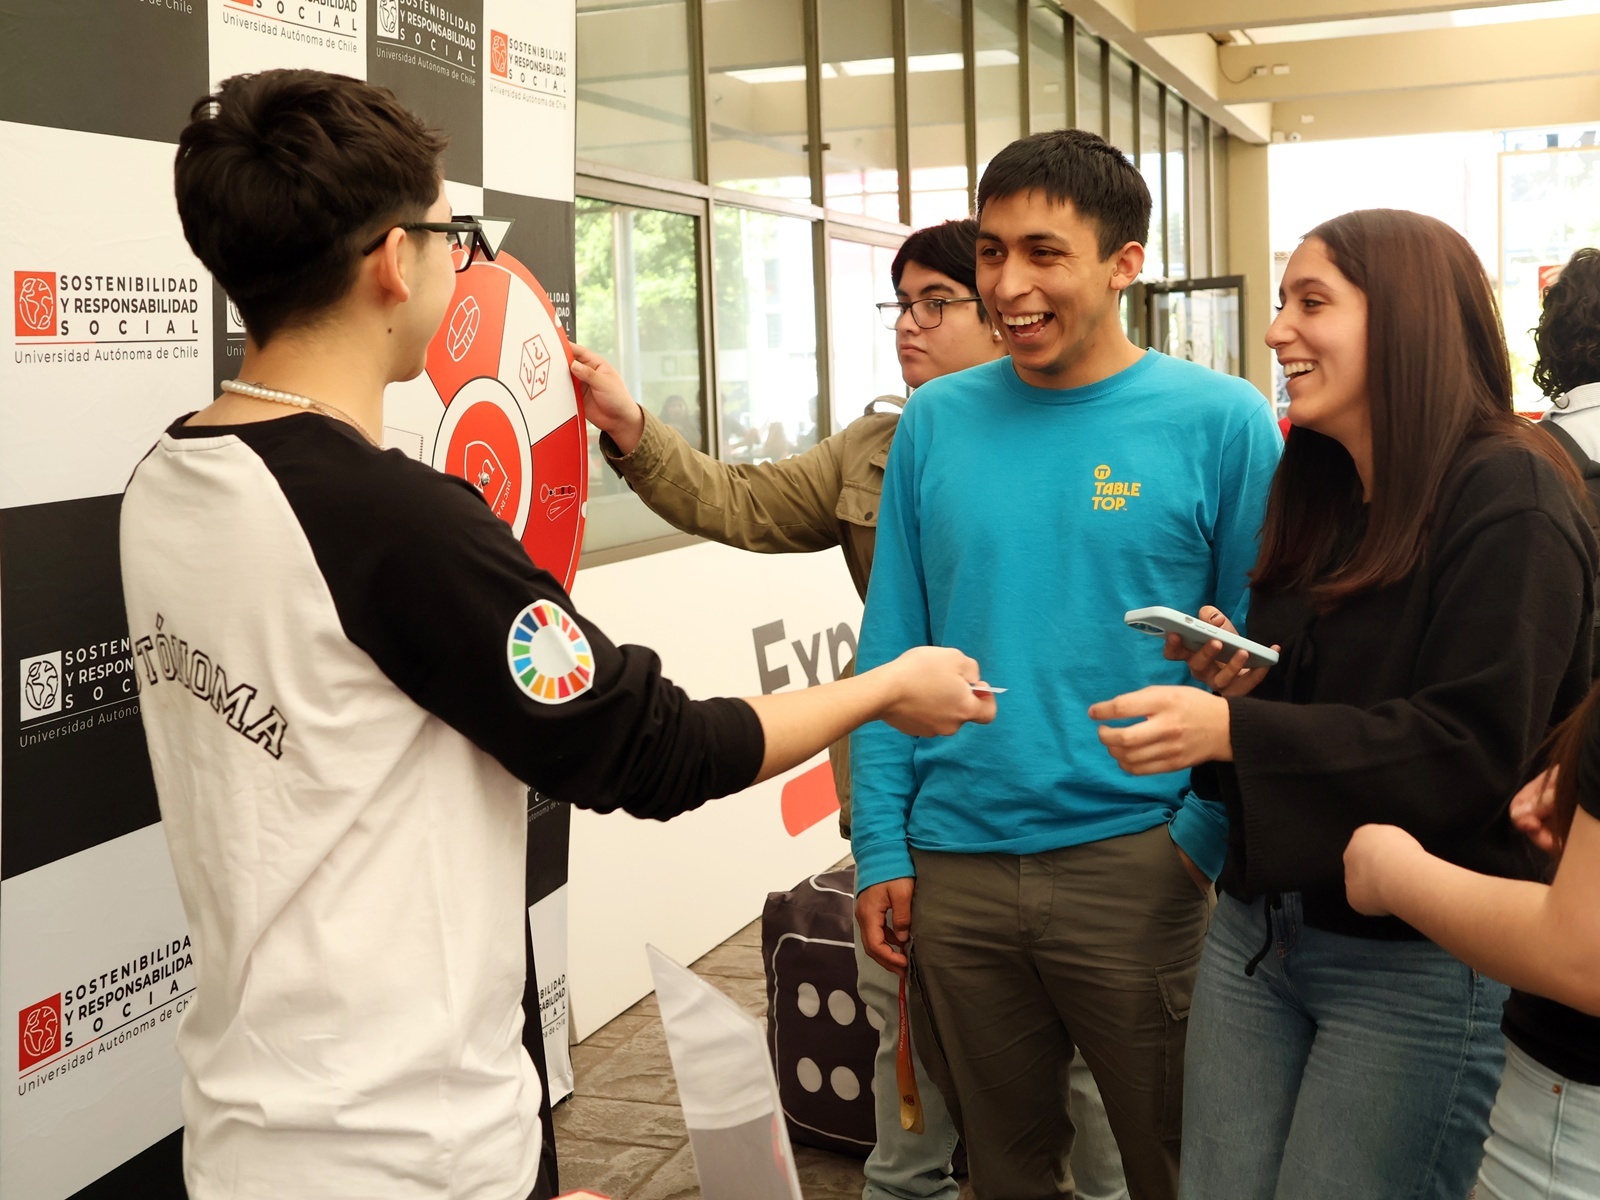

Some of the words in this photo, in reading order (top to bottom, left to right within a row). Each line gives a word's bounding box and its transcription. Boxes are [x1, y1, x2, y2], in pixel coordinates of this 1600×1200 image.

[222, 11, 278, 36] Universidad
[280, 27, 323, 47] Autónoma
[326, 37, 336, 49] de
[338, 39, 358, 54] Chile
[400, 9, 406, 22] Y
[407, 11, 476, 51] RESPONSABILIDAD
[400, 27, 476, 67] SOCIAL
[509, 38, 567, 62] SOSTENIBILIDAD
[376, 47, 416, 65] Universidad
[418, 57, 450, 77] Autónoma
[451, 69, 459, 80] de
[460, 72, 476, 86] Chile
[509, 53, 514, 64] Y
[514, 55, 567, 77] RESPONSABILIDAD
[60, 275, 198, 293] SOSTENIBILIDAD
[60, 298, 70, 313] Y
[74, 298, 198, 314] RESPONSABILIDAD
[60, 320, 198, 336] SOCIAL
[14, 349, 90, 364] Universidad
[95, 347, 152, 361] Autónoma
[156, 347, 169, 360] de
[173, 346, 199, 359] Chile
[1092, 496, 1126, 510] TOP
[1094, 482, 1142, 496] TABLE
[65, 637, 130, 666] SOSTEN
[65, 672, 75, 687] Y
[78, 657, 134, 684] RESPON
[65, 678, 131, 710] SOC
[19, 714, 94, 748] Universidad
[98, 704, 139, 726] Autóno
[64, 935, 192, 1007] SOSTENIBILIDA
[64, 1010, 74, 1026] Y
[78, 953, 193, 1021] RESPONSABILIDA
[65, 979, 179, 1048] SOCIA
[18, 1047, 94, 1096] Universidad
[98, 1016, 156, 1056] Autónoma
[160, 1008, 172, 1022] de
